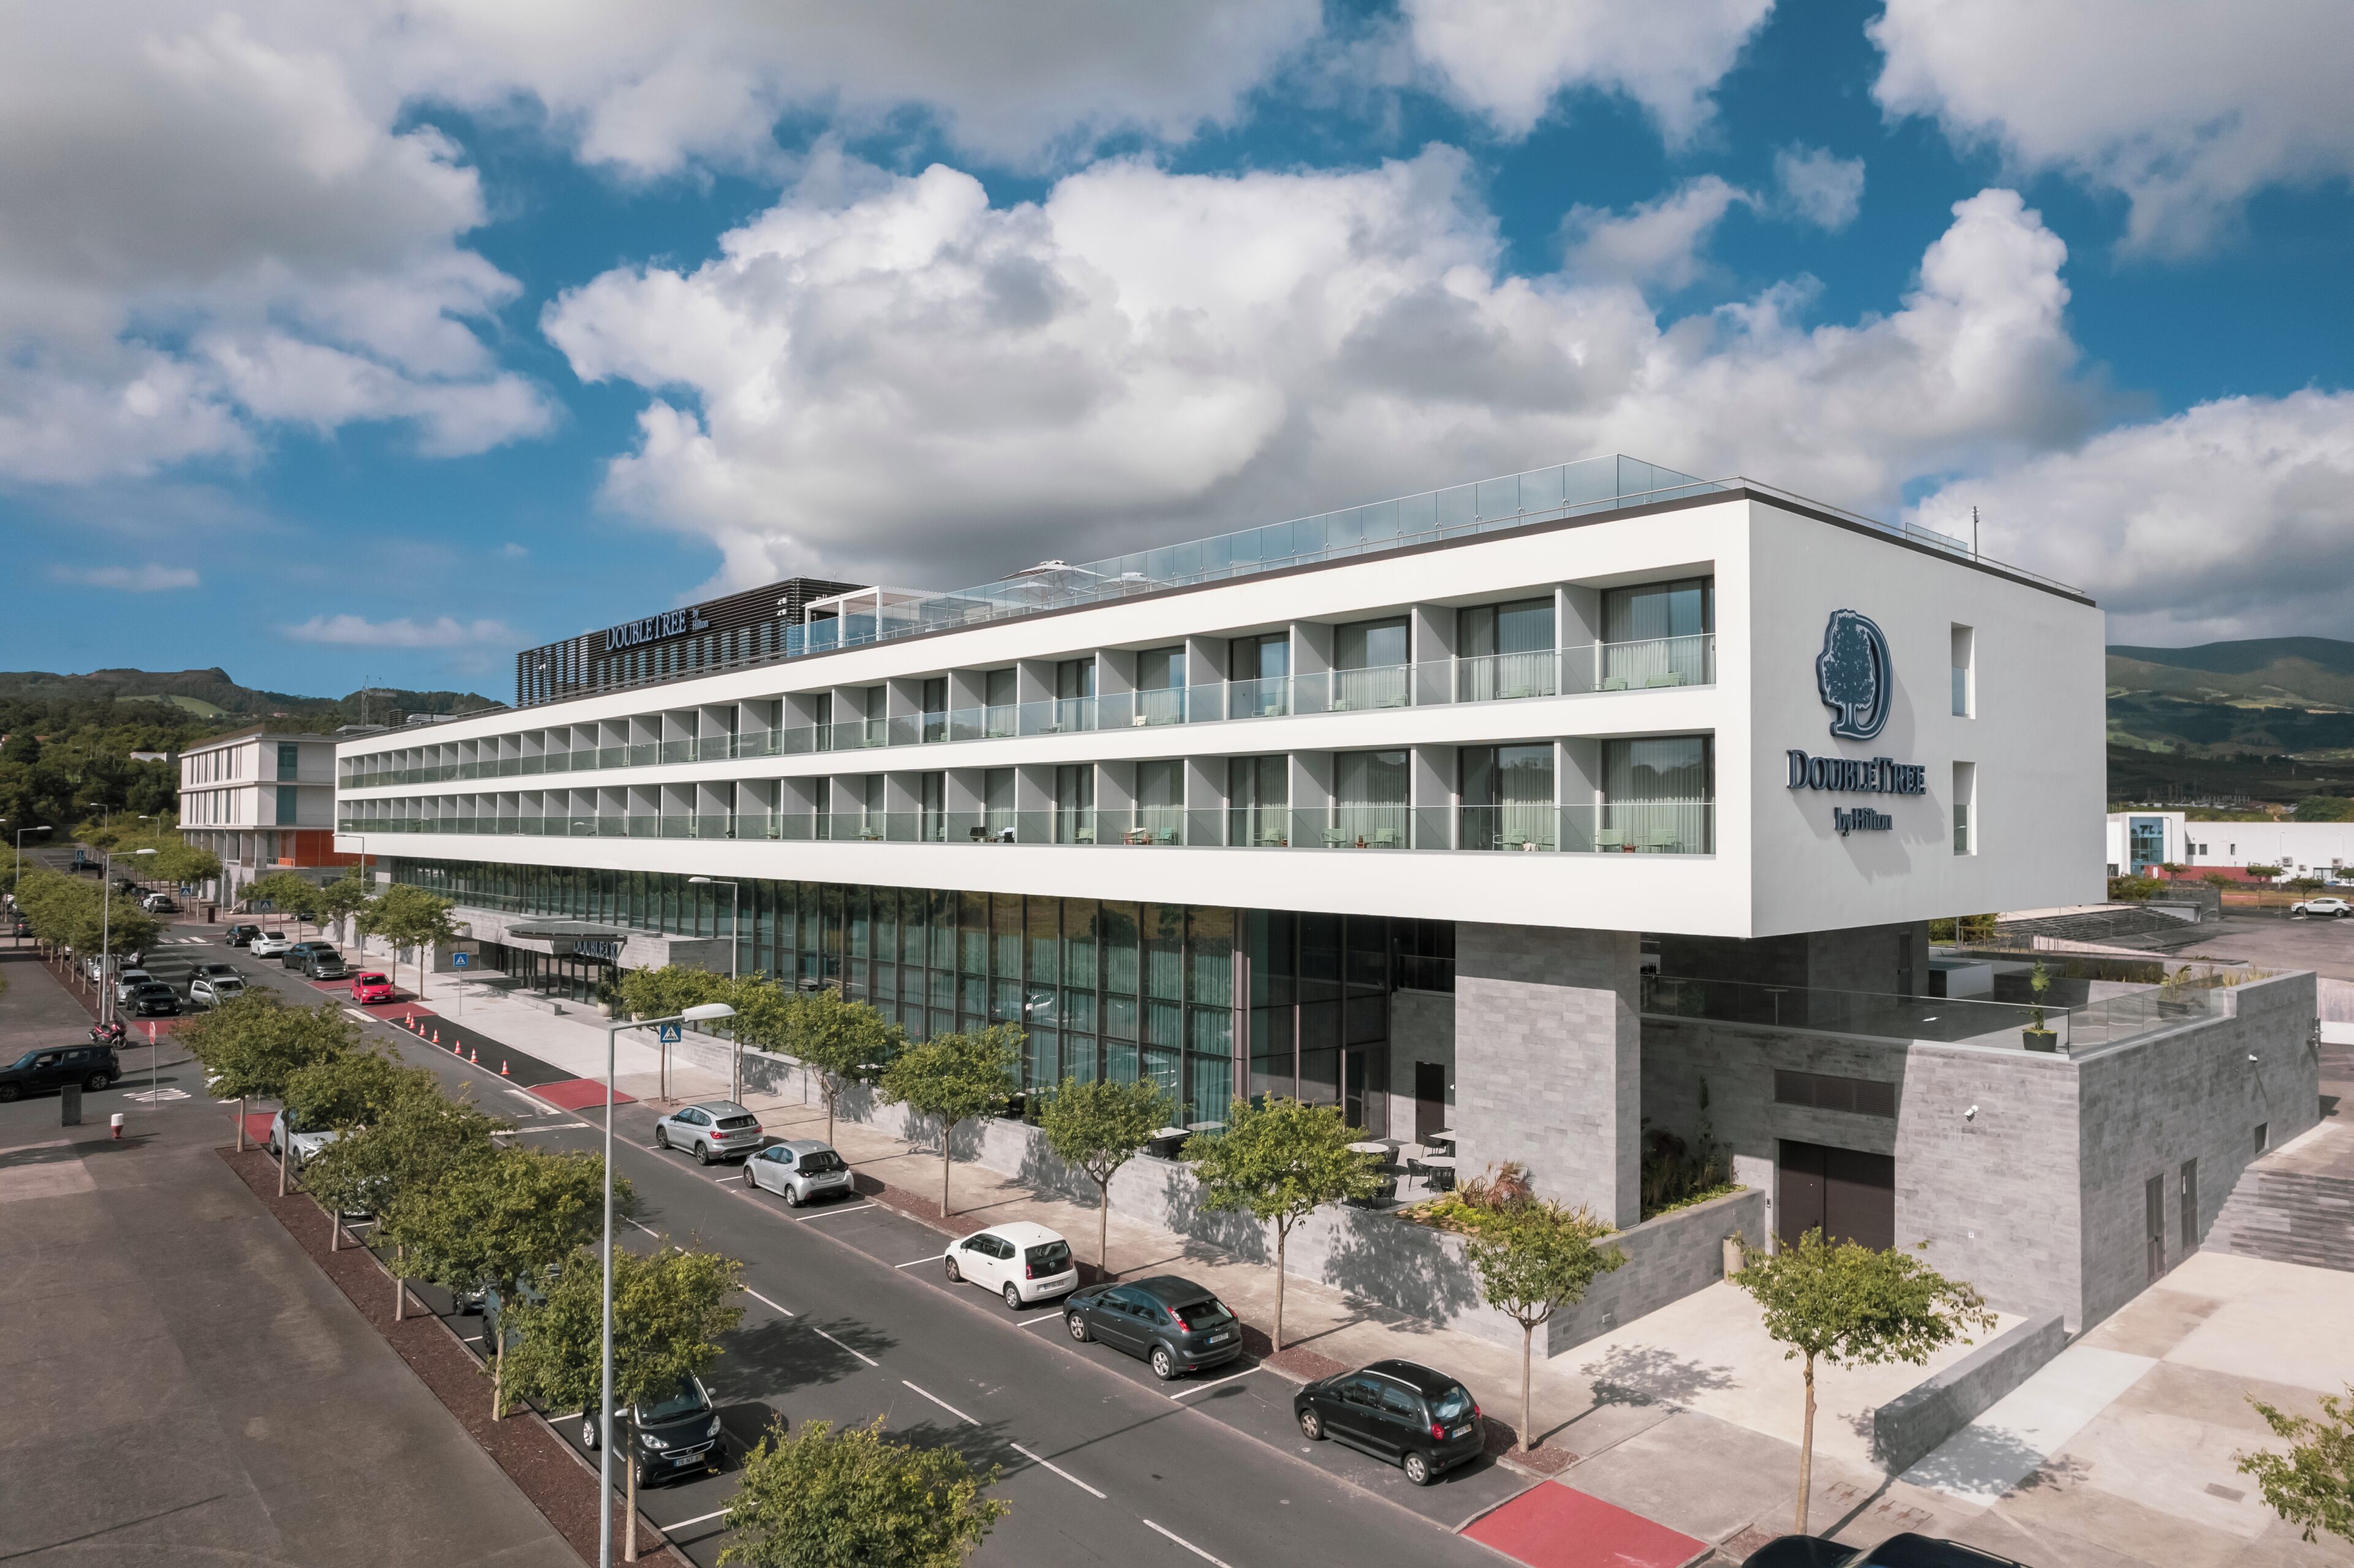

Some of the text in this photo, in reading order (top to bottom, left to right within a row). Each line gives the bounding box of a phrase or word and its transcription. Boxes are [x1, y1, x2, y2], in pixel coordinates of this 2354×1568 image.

[605, 607, 699, 651] DOUBLETREE by
[692, 620, 709, 631] Hilton
[1786, 749, 1927, 795] DOUBLETREE
[1834, 807, 1892, 837] by Hilton
